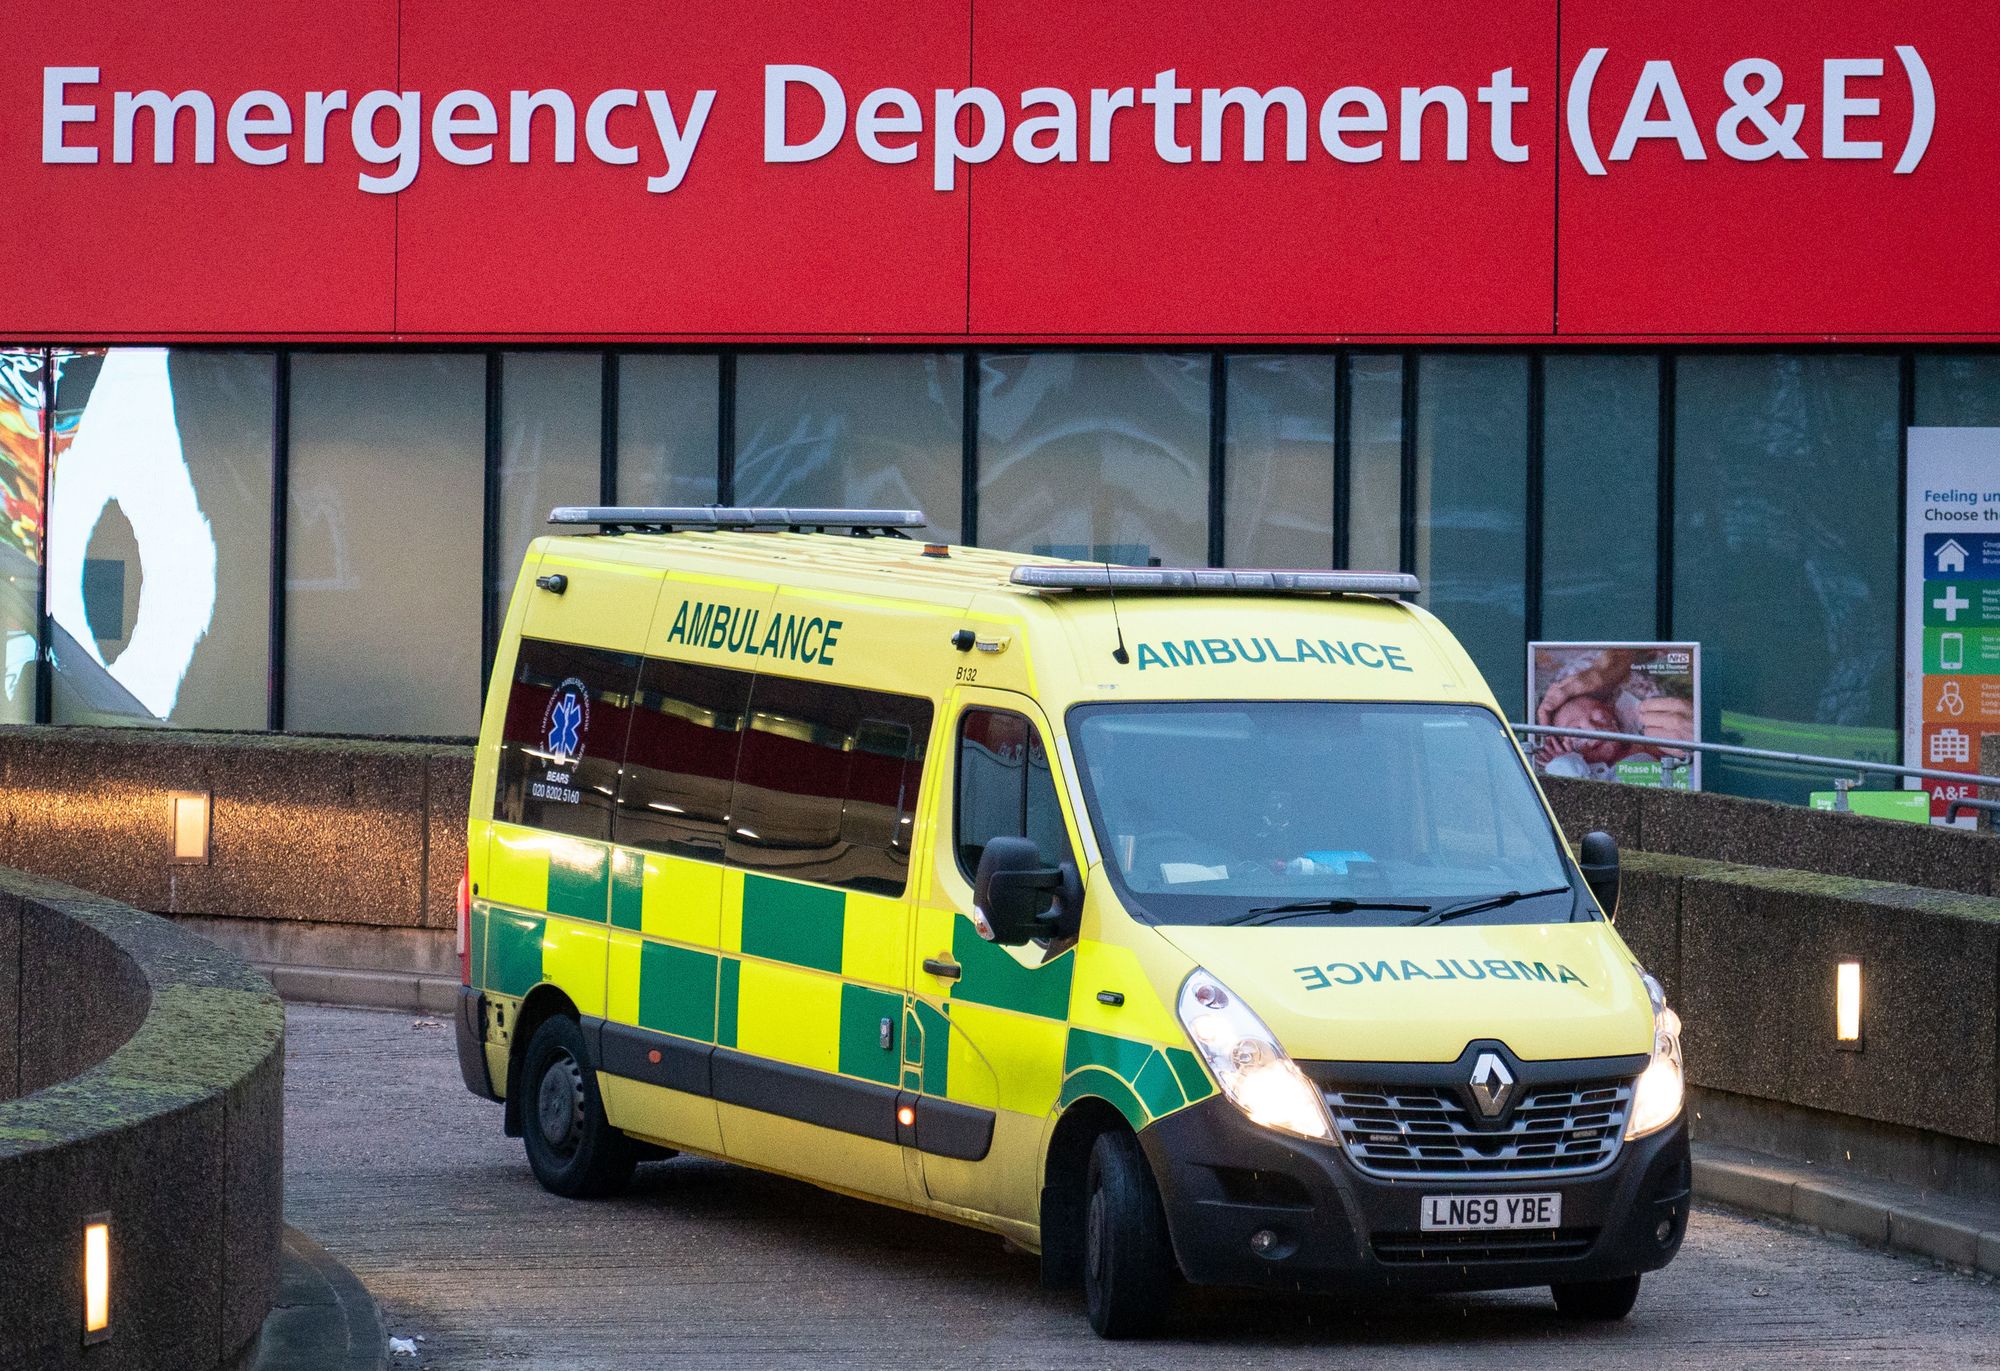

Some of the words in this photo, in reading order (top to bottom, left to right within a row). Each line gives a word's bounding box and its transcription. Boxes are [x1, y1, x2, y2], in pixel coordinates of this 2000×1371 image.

[42, 66, 717, 194] Emergency
[763, 64, 1529, 191] Department
[1566, 45, 1937, 176] (A&E)
[1925, 489, 1978, 505] Feeling
[1924, 508, 1978, 521] Choose
[1983, 508, 2000, 521] th
[667, 600, 843, 666] AMBULANCE
[1137, 637, 1414, 672] AMBULANCE
[1668, 654, 1689, 662] NHS
[956, 666, 978, 682] B132
[1618, 764, 1649, 774] Please
[546, 770, 570, 785] BEARS
[532, 783, 545, 798] 020
[545, 785, 562, 801] 8202
[562, 788, 580, 804] 5160
[1431, 1199, 1498, 1226] LN69
[1506, 1197, 1552, 1224] YBE
